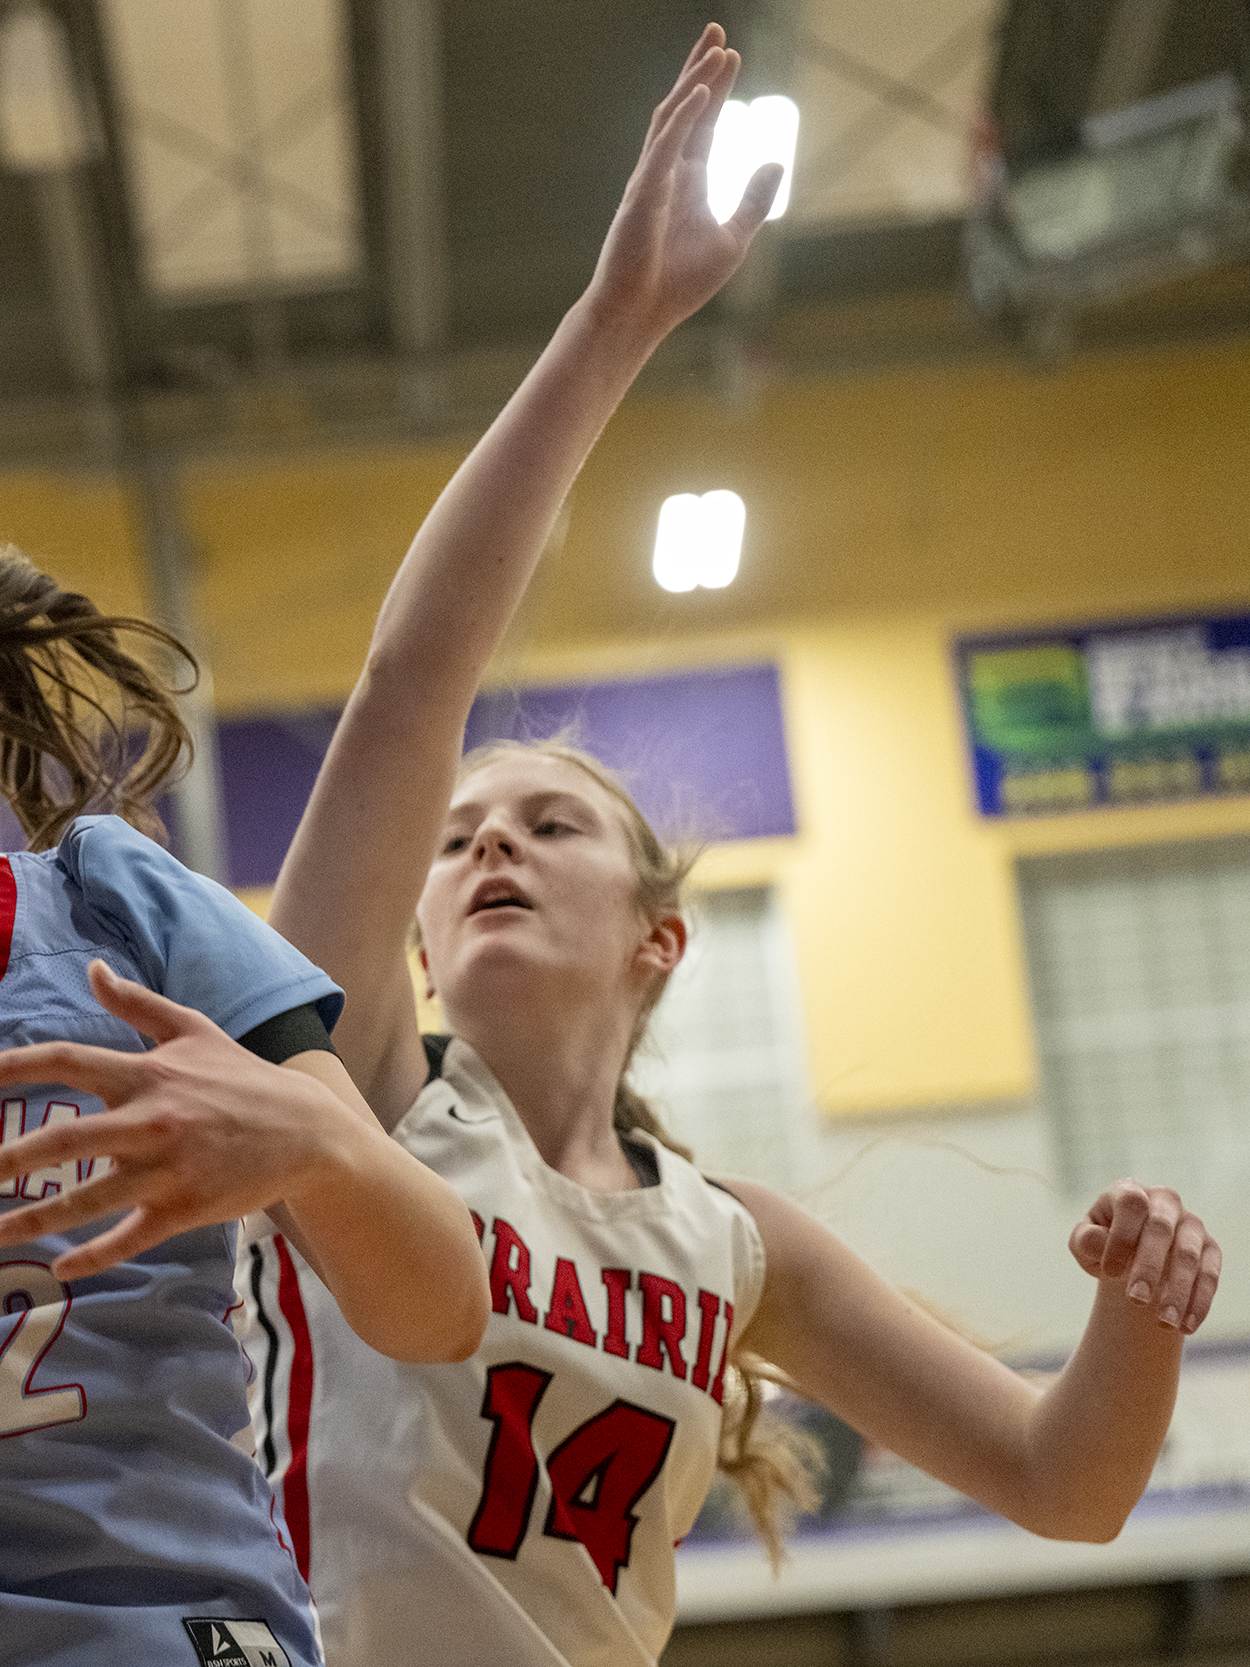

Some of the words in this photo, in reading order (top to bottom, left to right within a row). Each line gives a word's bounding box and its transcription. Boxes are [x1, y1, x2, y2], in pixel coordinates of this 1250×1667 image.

[467, 1208, 734, 1407] RAIRI
[467, 1361, 676, 1599] 14
[259, 1651, 278, 1667] M
